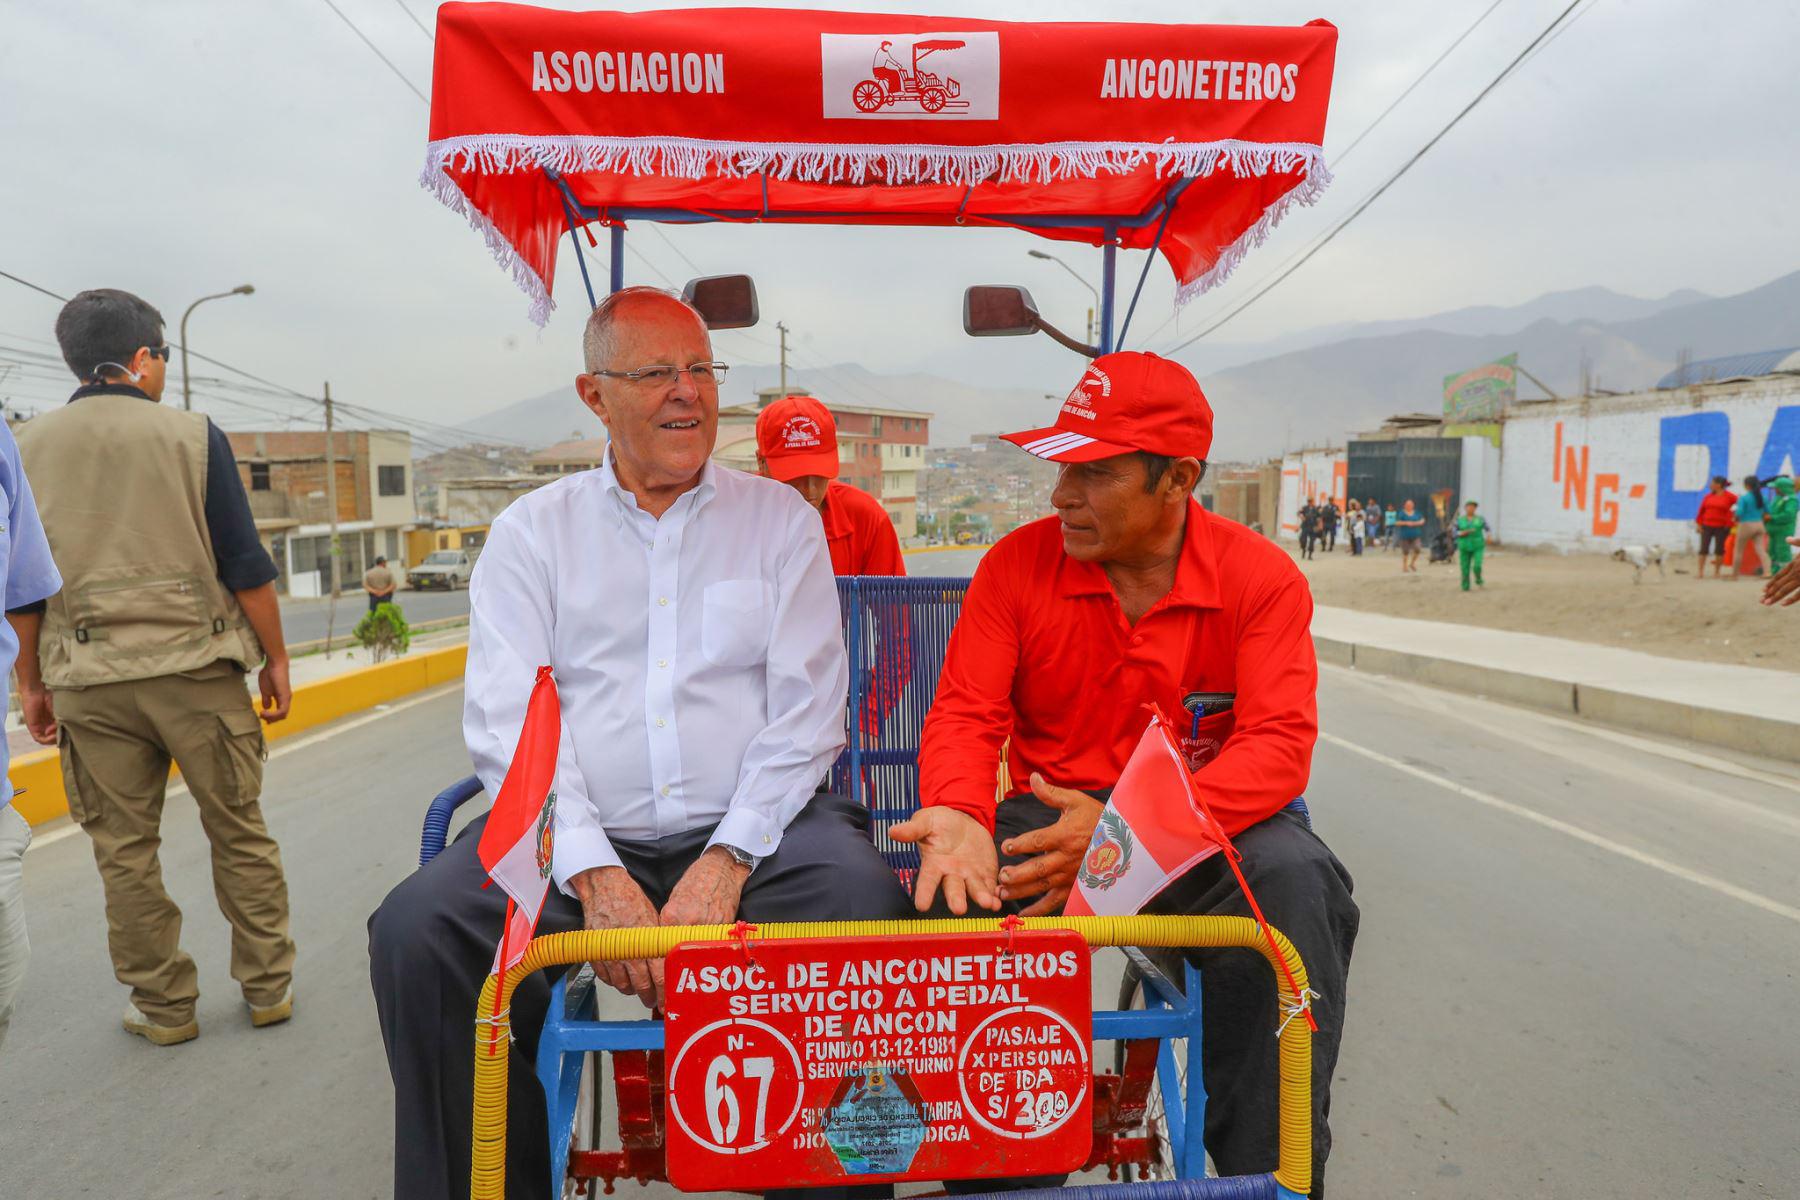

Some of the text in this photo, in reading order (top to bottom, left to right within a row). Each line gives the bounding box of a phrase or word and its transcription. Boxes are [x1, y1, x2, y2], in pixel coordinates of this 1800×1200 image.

[532, 51, 725, 93] ASOCIACION
[1100, 59, 1298, 102] ANCONETEROS
[676, 951, 1078, 993] ASOC. DE ANCONETEROS
[729, 983, 1029, 1016] SERVICIO A PEDAL
[804, 1010, 957, 1038] DE ANCON
[986, 1025, 1061, 1046] PASAJE
[805, 1040, 864, 1060] FUNDO
[972, 1049, 1076, 1068] X PERSONA
[979, 1067, 1054, 1093] DE IDA
[704, 1054, 775, 1145] 67
[921, 1100, 963, 1122] TARIFA
